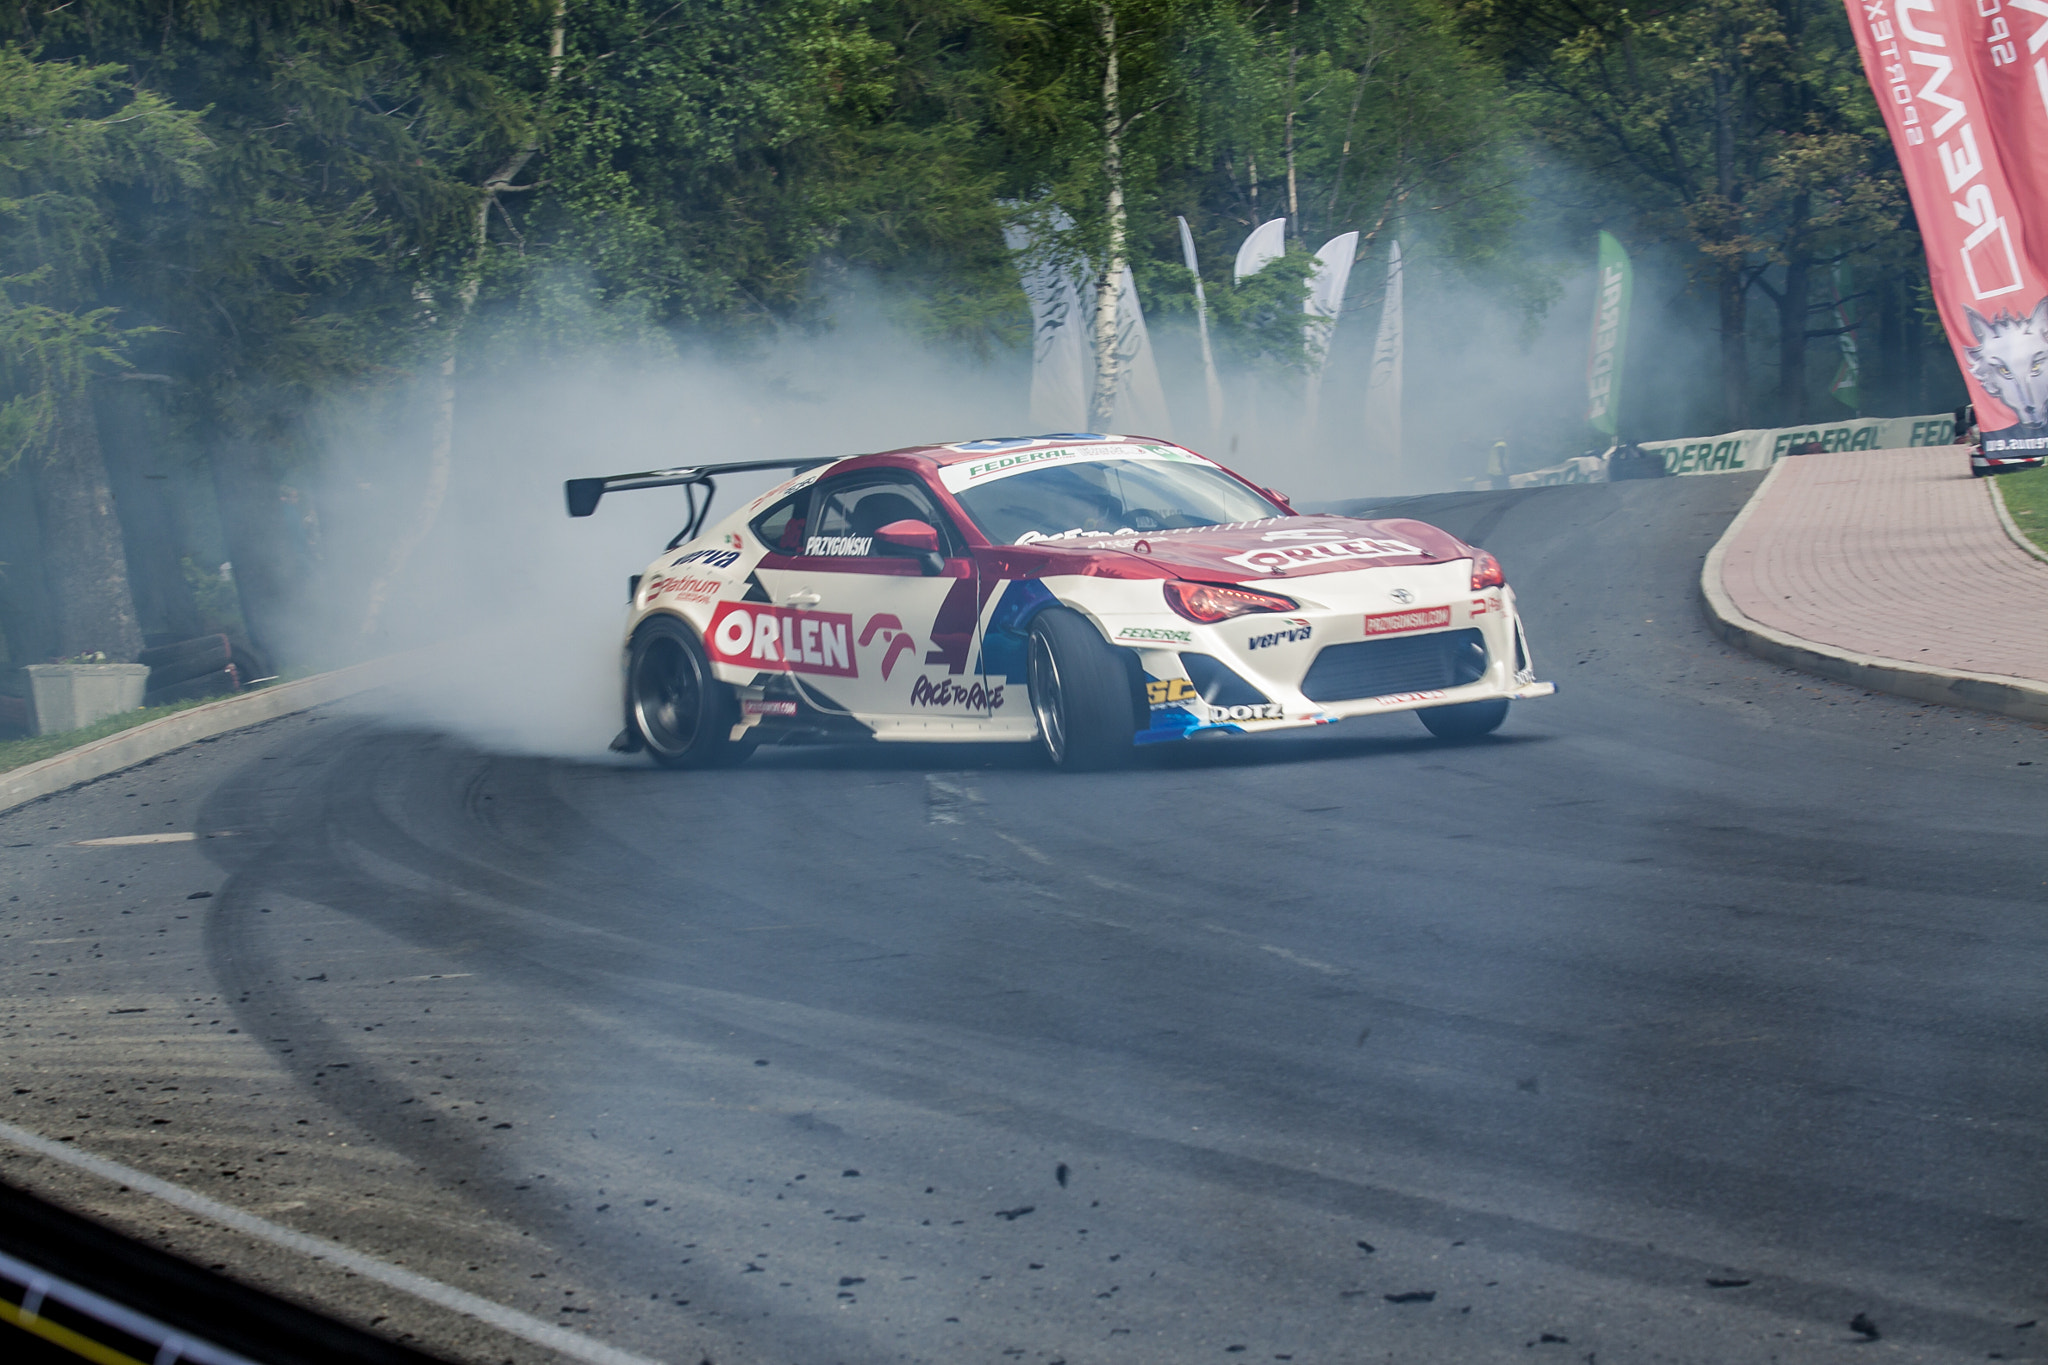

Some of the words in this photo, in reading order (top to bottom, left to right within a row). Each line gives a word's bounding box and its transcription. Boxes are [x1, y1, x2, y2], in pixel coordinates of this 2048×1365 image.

[969, 449, 1074, 476] FEDERAL
[1651, 440, 1745, 475] DERAL
[804, 532, 872, 556] PRZYGOŃSKI
[1247, 541, 1412, 566] ORLEN
[714, 609, 849, 669] ORLEN
[1118, 627, 1191, 641] FEDERAL
[1248, 626, 1311, 650] verva
[1210, 704, 1283, 722] DOTZ
